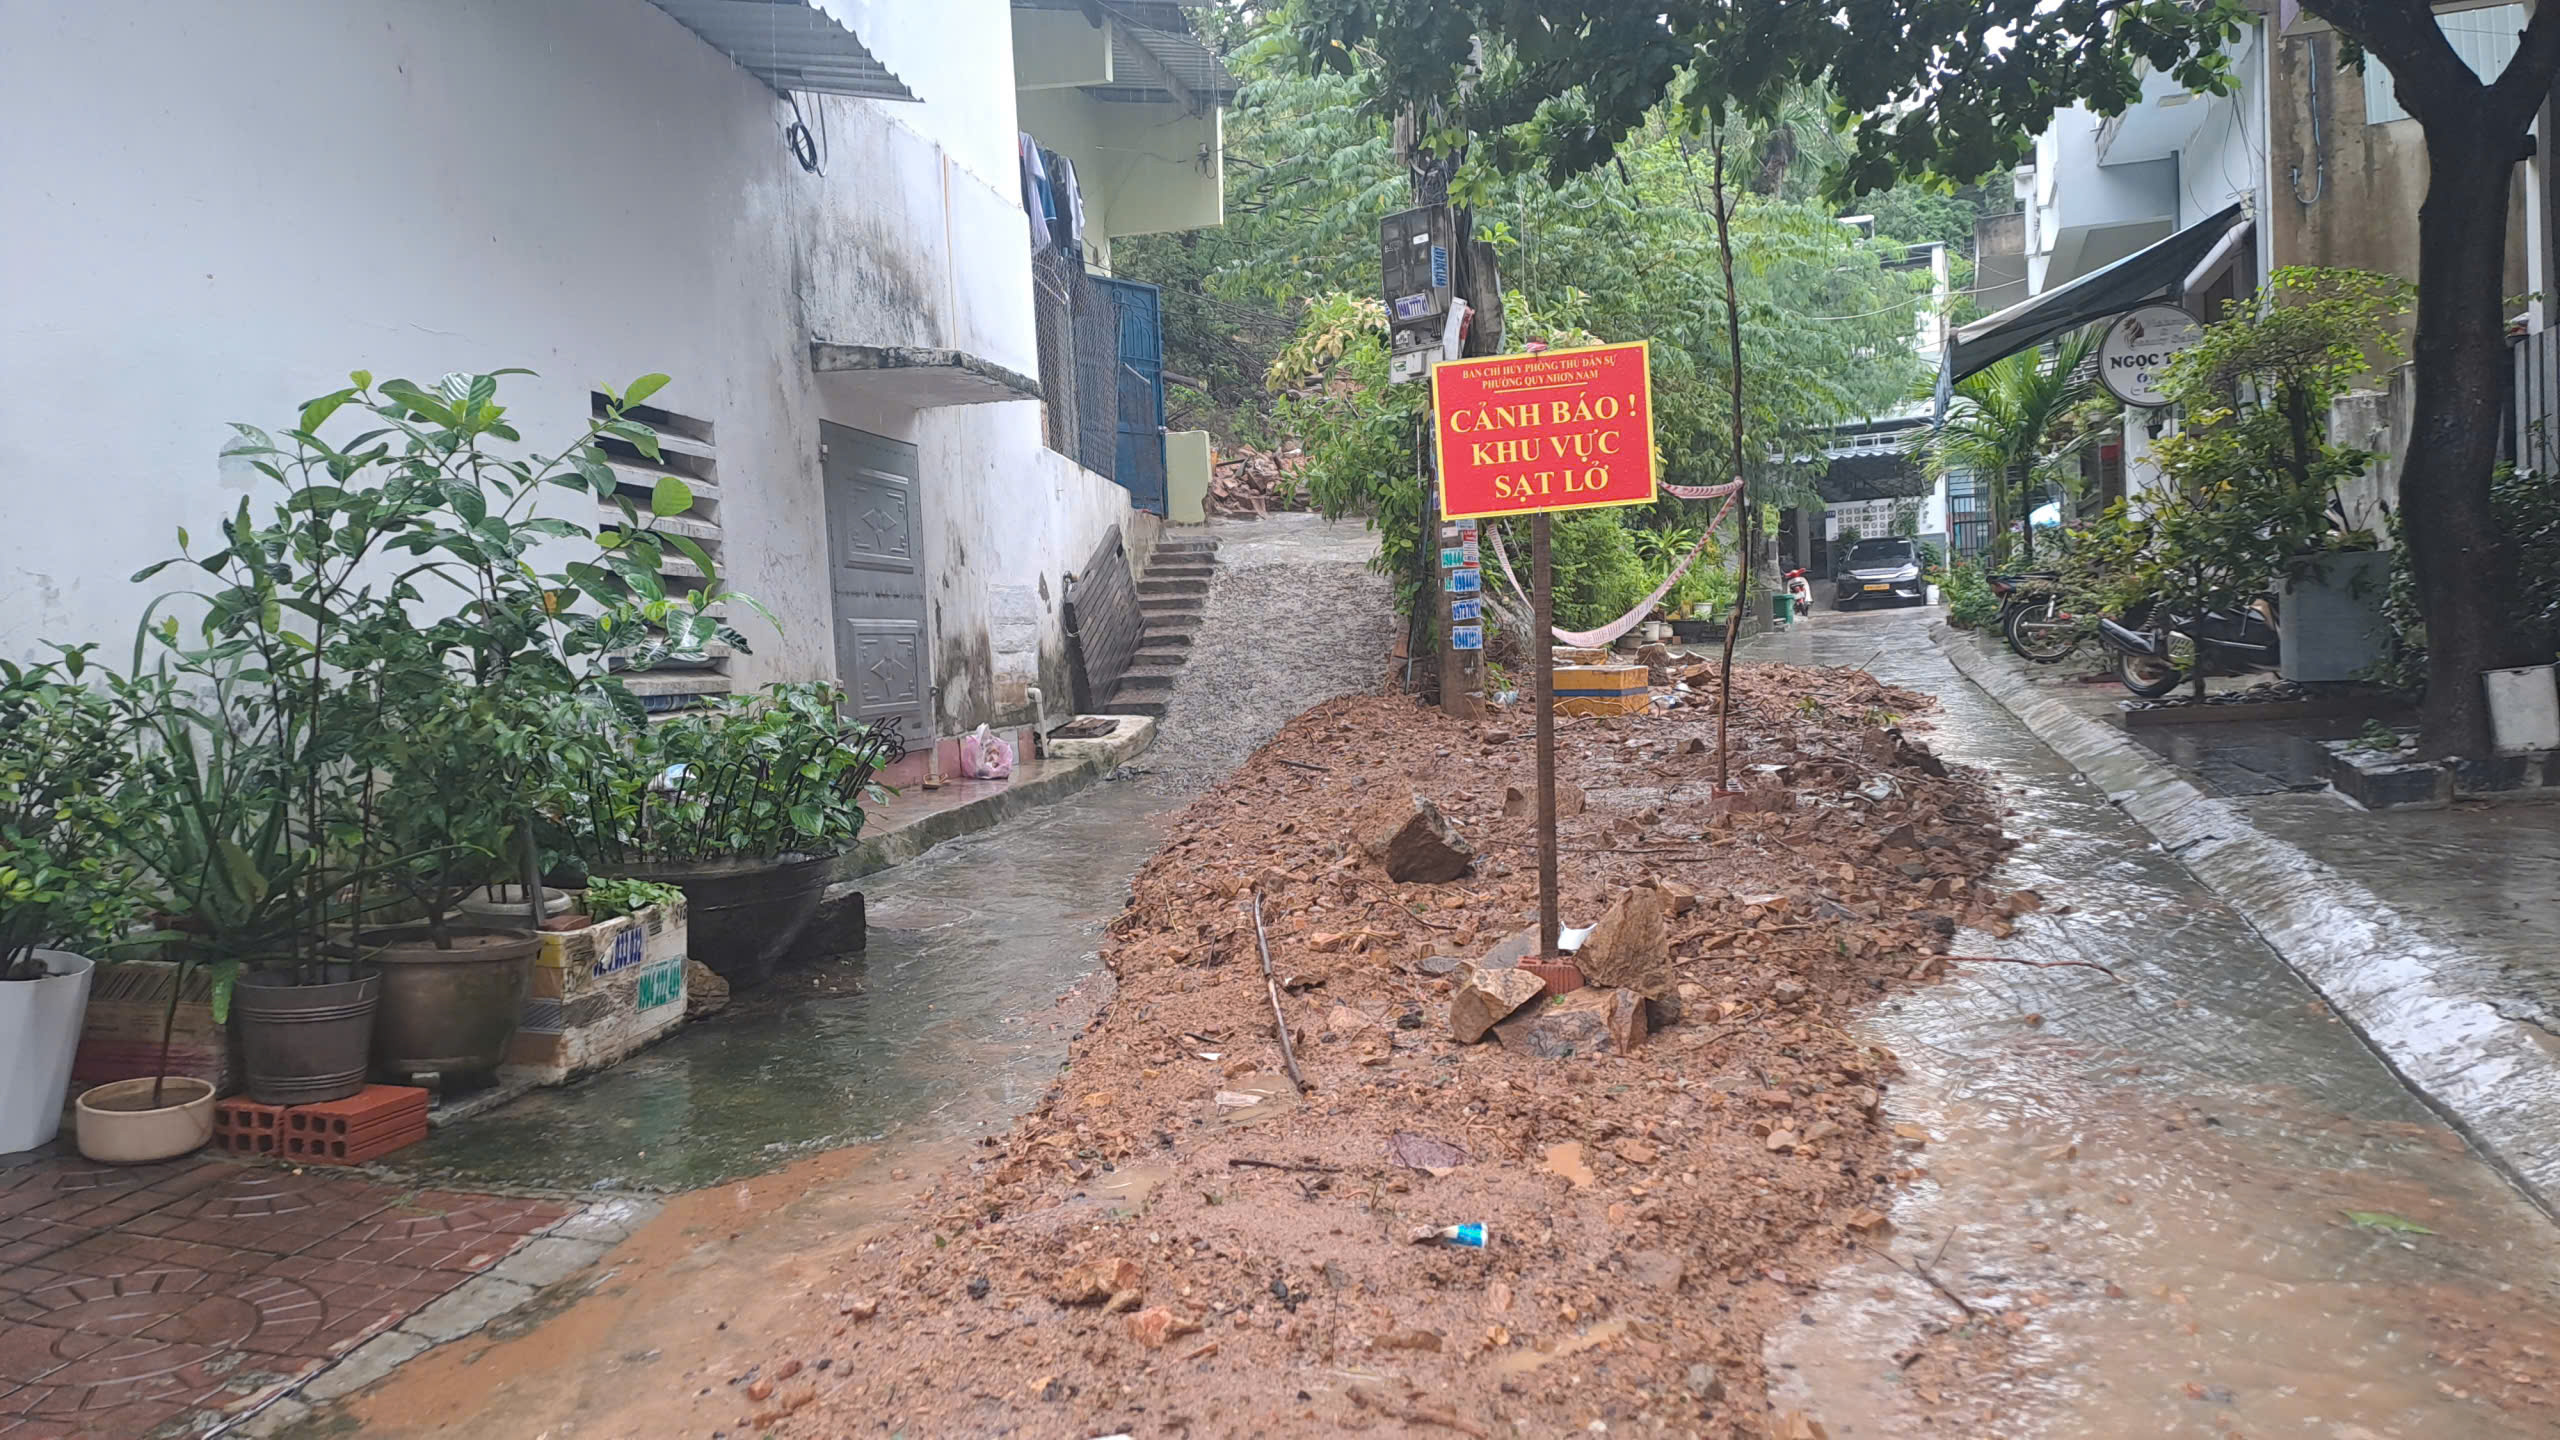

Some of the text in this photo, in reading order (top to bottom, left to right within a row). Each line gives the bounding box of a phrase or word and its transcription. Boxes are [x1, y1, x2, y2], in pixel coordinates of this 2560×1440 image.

[1463, 369, 1482, 379] BAN
[1484, 365, 1500, 376] CHỈ
[1503, 365, 1521, 375] HUY
[1525, 359, 1558, 372] PHÒNG
[1582, 354, 1602, 367] DÂN
[1604, 353, 1617, 367] SỰ
[2110, 353, 2159, 370] NGỌC
[1482, 370, 1599, 389] PHƯỜNG QUY NHƠN NAM
[1450, 391, 1637, 433] CẢNH BÁO !
[1471, 429, 1621, 466] KHU VỰC
[1494, 460, 1610, 503] SẠT LỞ
